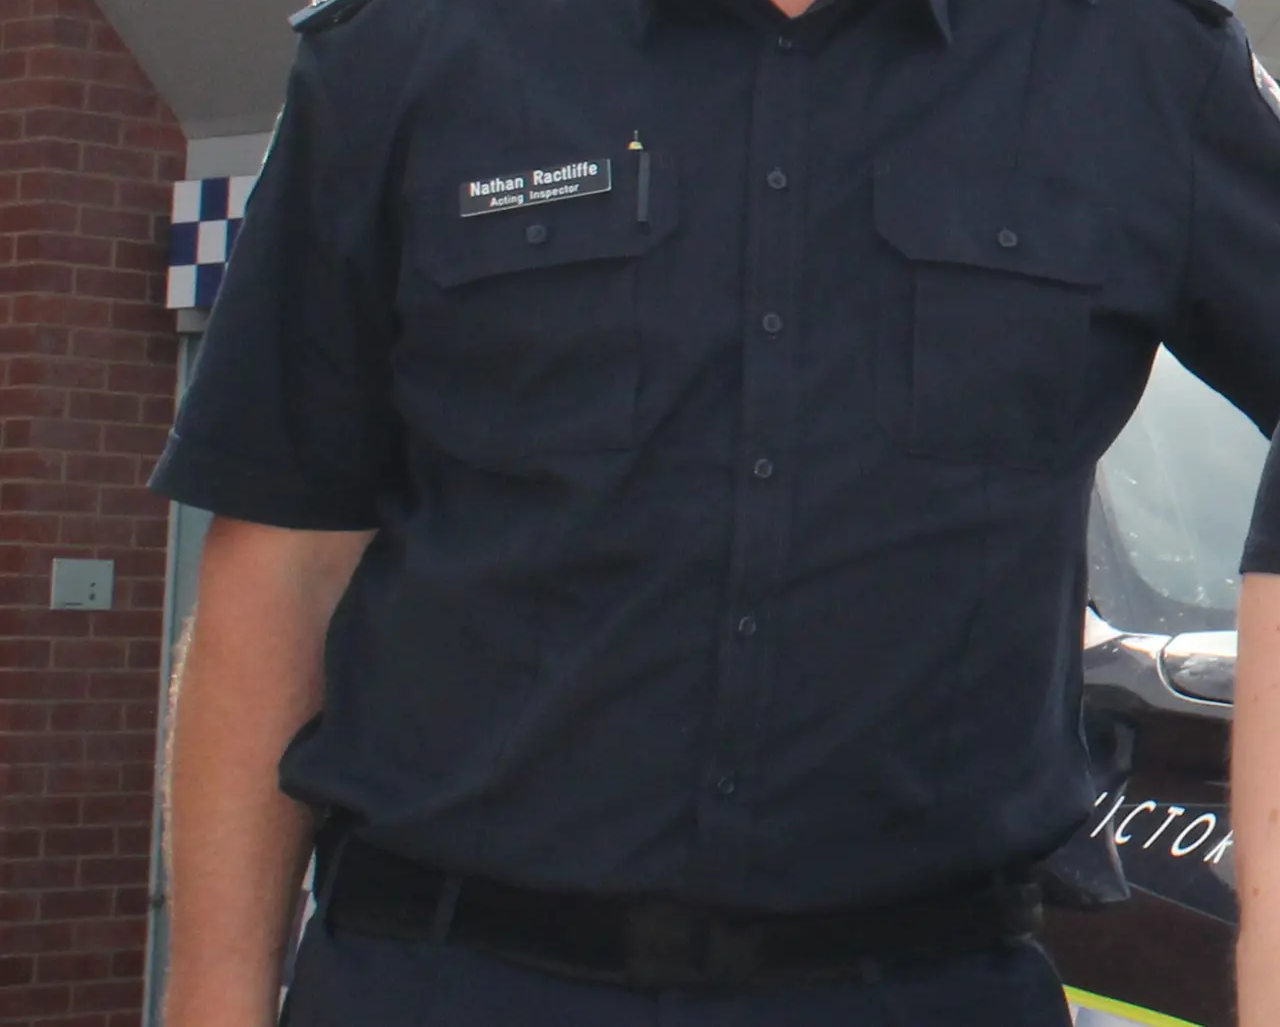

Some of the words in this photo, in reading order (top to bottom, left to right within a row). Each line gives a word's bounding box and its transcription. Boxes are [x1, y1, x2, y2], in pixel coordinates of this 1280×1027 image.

[470, 177, 524, 197] Nathan
[533, 161, 598, 186] Ractliffe
[490, 193, 524, 207] Acting
[529, 183, 580, 200] Inspector
